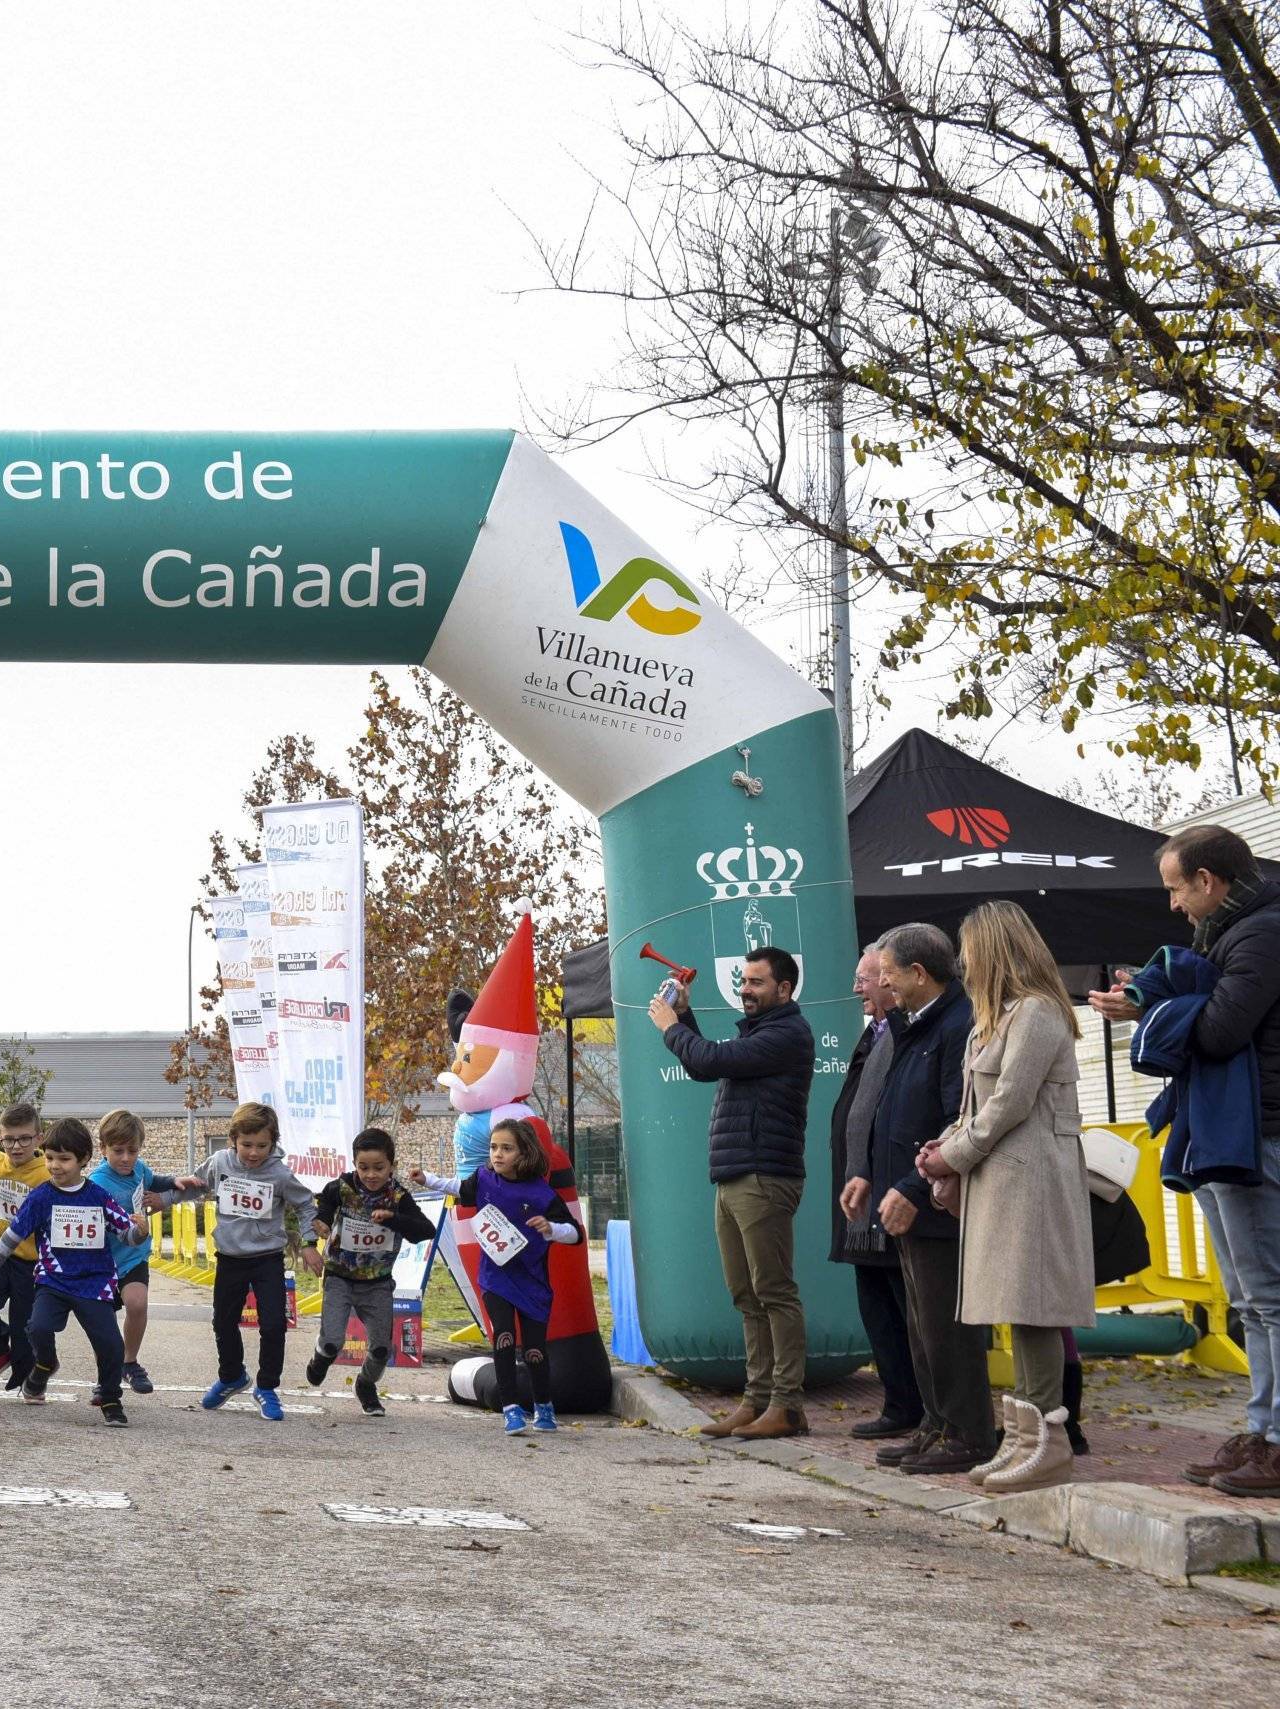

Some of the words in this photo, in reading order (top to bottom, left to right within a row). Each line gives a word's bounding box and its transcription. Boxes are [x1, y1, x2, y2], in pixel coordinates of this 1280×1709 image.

[203, 451, 294, 500] de
[49, 548, 106, 608] la
[142, 545, 428, 608] Cañada
[536, 625, 695, 688] Villanueva
[524, 672, 542, 687] de
[546, 676, 558, 692] la
[566, 669, 687, 720] Cañada
[521, 695, 638, 733] SENCILLAMENTE
[644, 725, 683, 743] TODO
[884, 851, 1117, 877] TREK
[821, 1032, 838, 1048] de
[2, 1202, 18, 1216] 10
[231, 1193, 263, 1210] 150
[63, 1223, 96, 1239] 115
[352, 1234, 385, 1246] 100
[480, 1222, 508, 1253] 104
